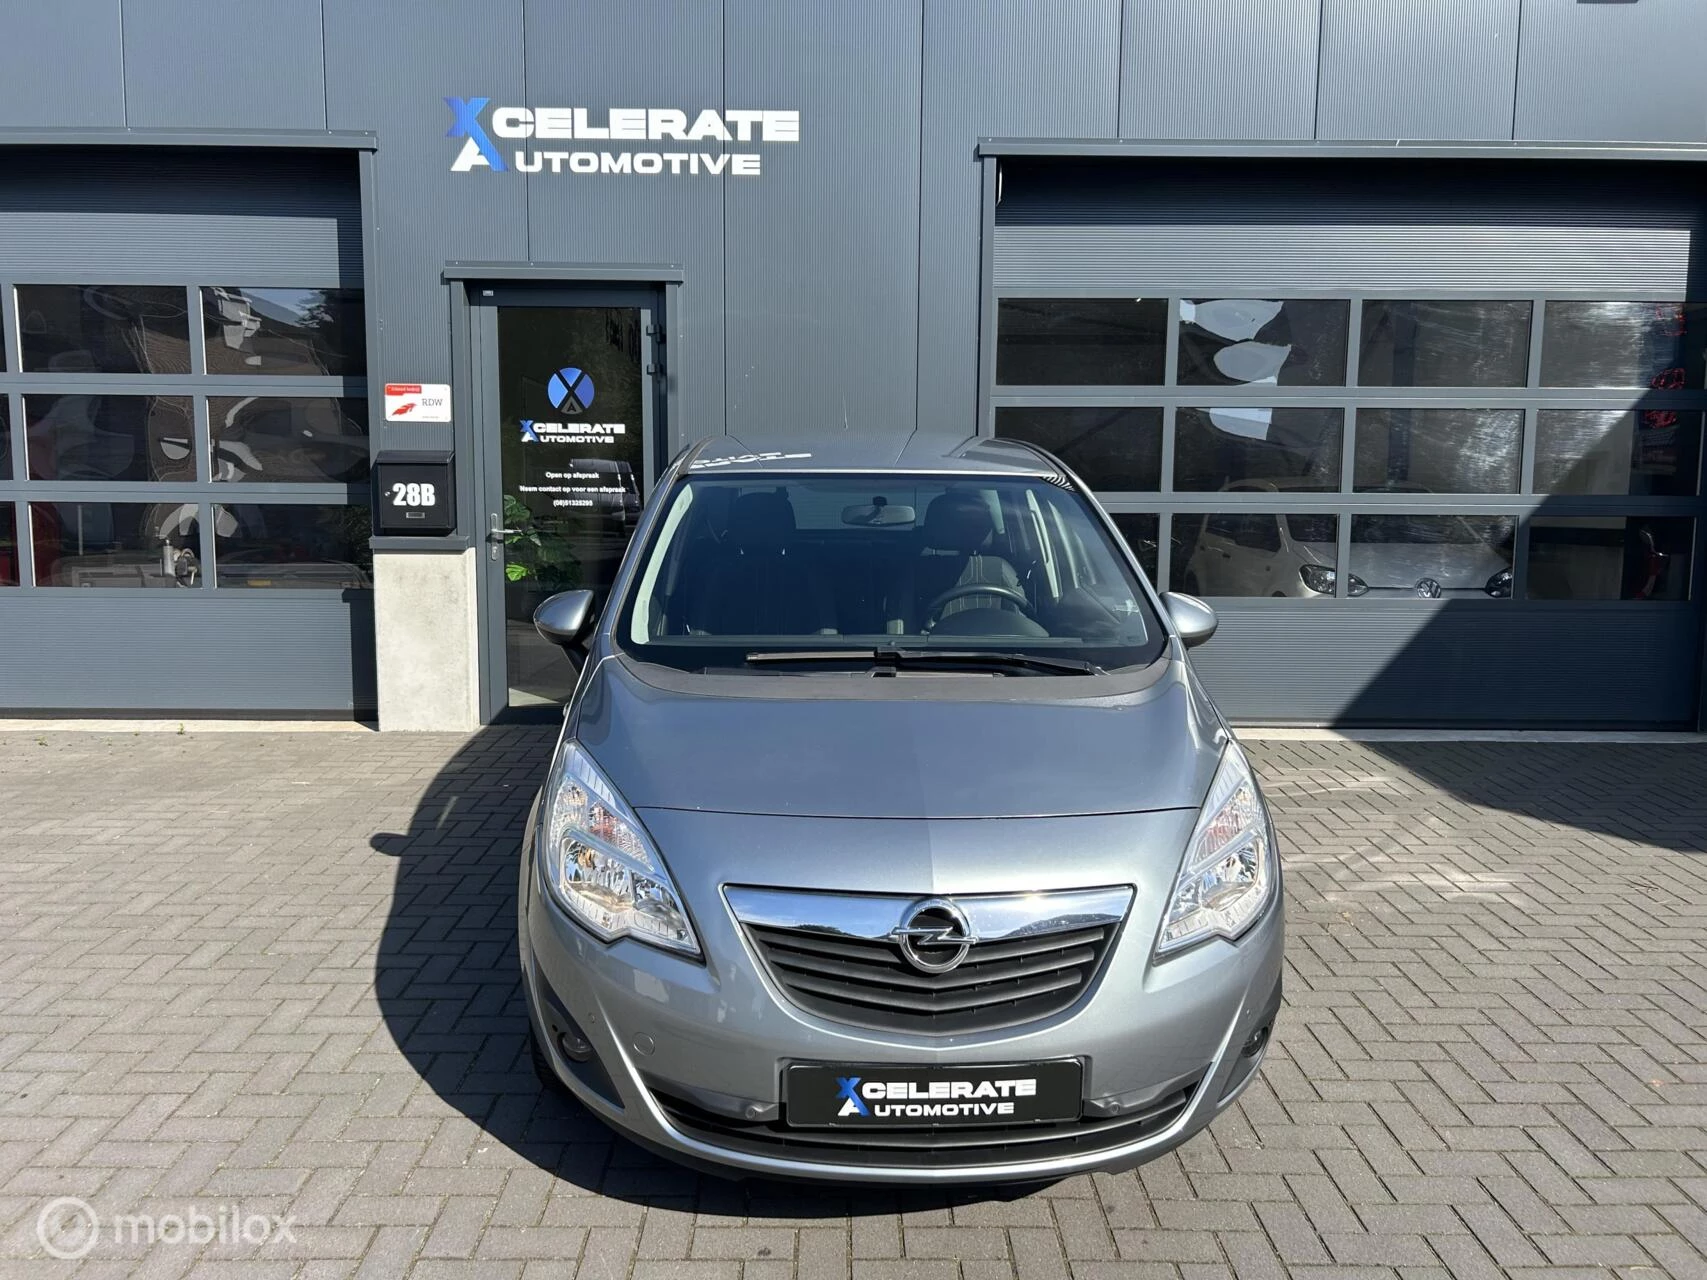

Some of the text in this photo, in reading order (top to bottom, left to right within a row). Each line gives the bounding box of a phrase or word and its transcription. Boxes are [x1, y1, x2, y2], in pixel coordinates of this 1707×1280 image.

[443, 97, 799, 142] XCELERATE
[450, 137, 761, 175] AUTOMOTIVE
[422, 398, 443, 406] RDW
[520, 420, 626, 434] XCELERATE
[521, 432, 615, 443] AUTOMOTIVE
[545, 471, 562, 479] Open
[392, 483, 436, 506] 28B
[835, 1077, 1037, 1099] XCELERATE
[837, 1097, 1014, 1116] AUTOMOTIVE
